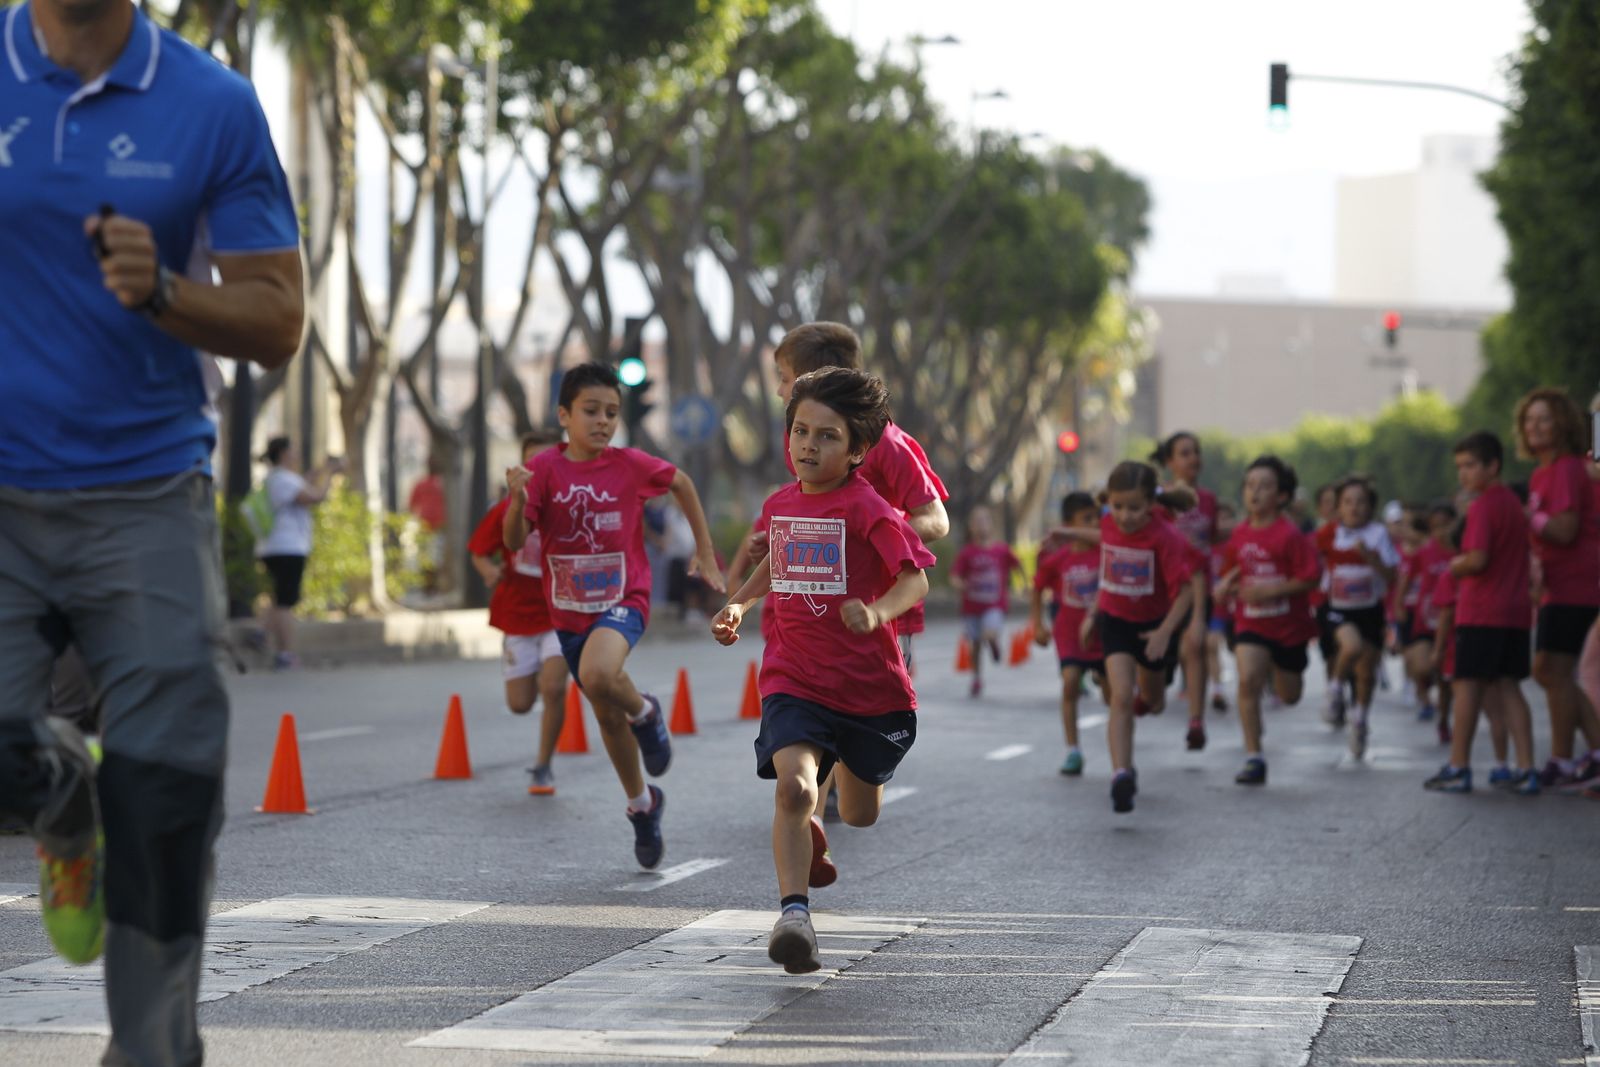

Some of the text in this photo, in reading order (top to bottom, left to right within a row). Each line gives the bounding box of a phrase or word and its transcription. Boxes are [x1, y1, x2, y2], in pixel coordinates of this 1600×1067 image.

[785, 542, 840, 565] 1770
[787, 565, 833, 574] DANIEL ROMERO
[888, 730, 909, 741] oma
